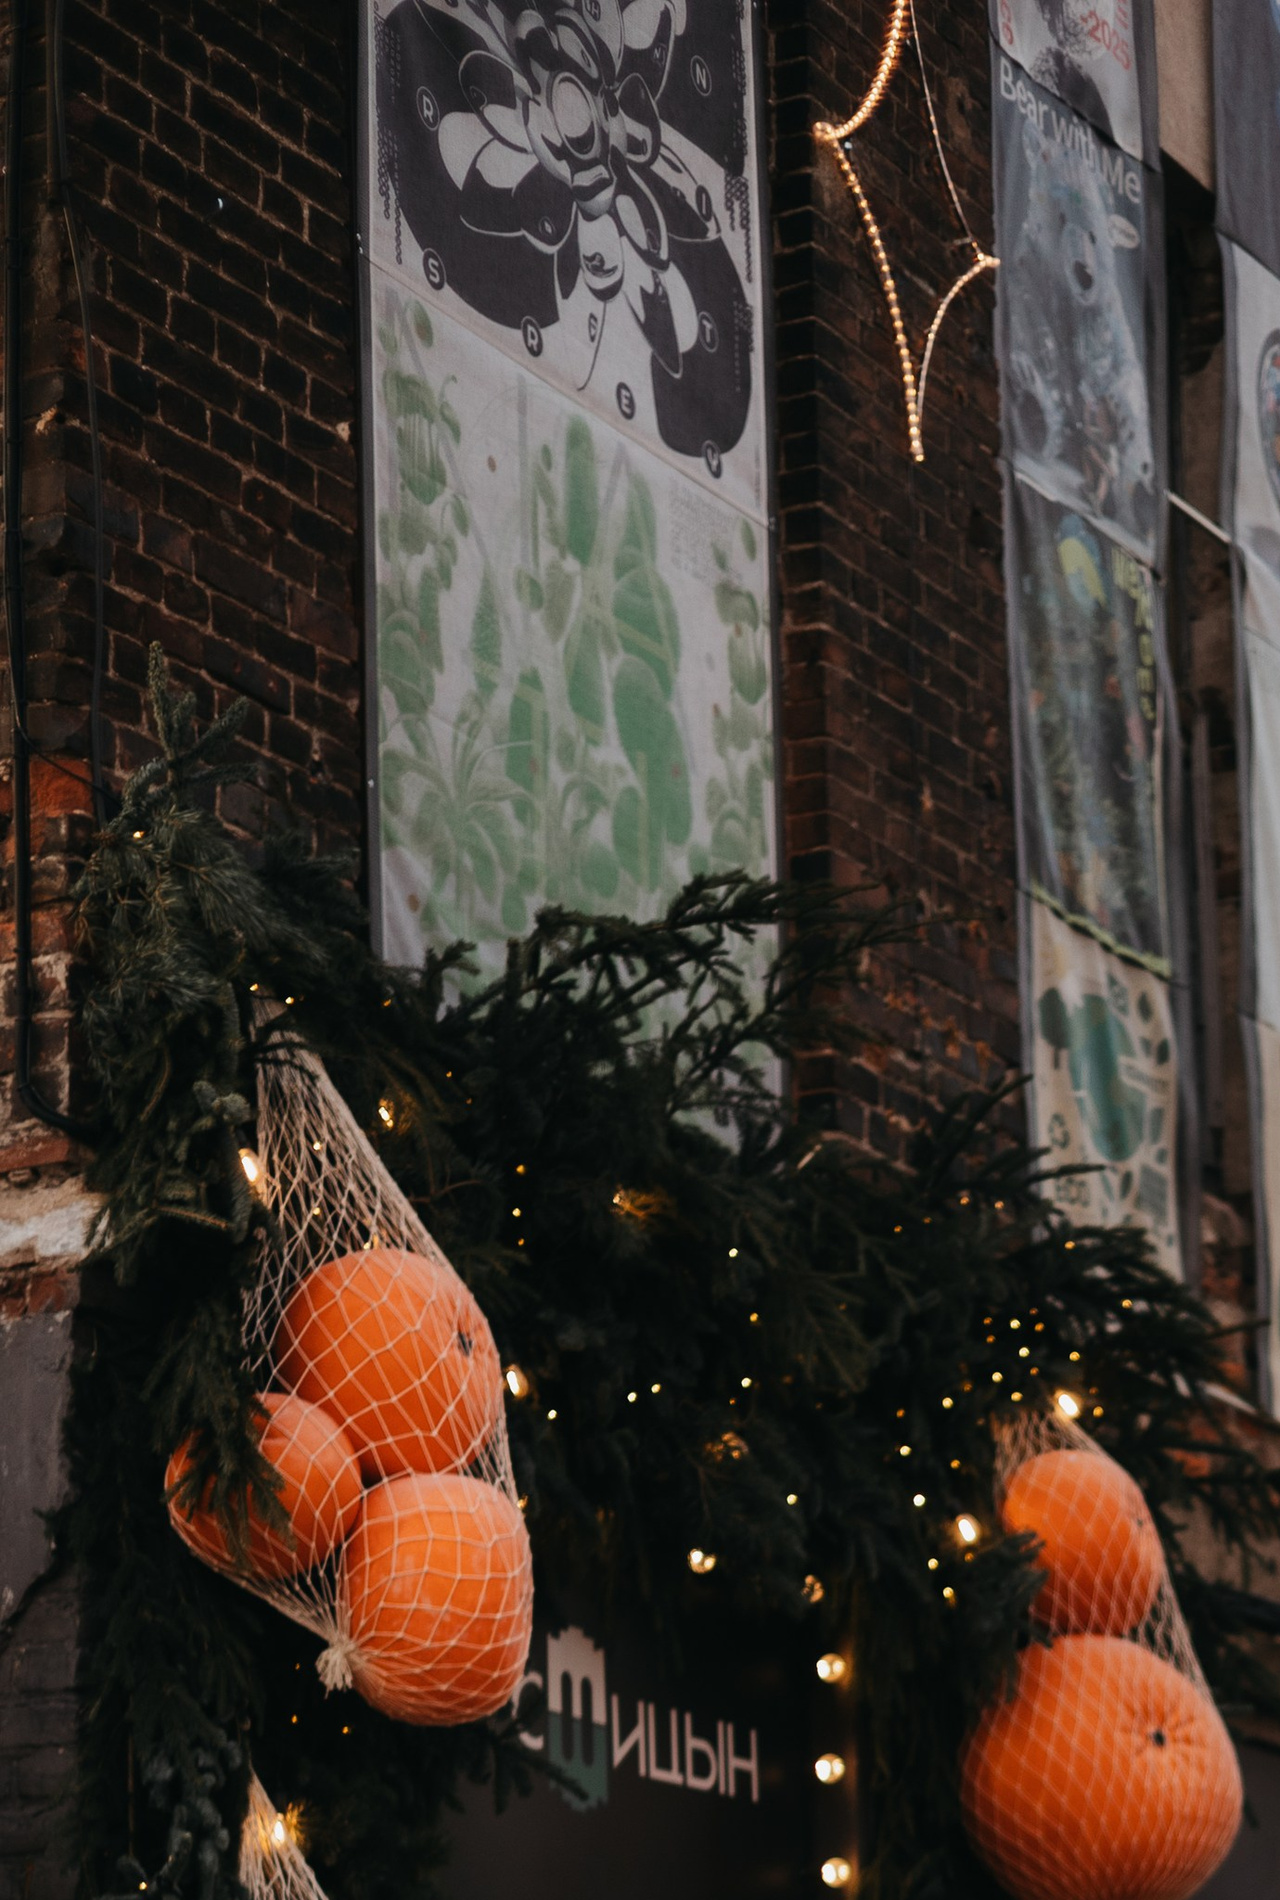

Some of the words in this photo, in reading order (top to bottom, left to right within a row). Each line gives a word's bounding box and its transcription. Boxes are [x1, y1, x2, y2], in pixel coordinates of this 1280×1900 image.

[1000, 56, 1048, 137] Bear
[1052, 112, 1096, 168] with
[1102, 146, 1142, 204] Me
